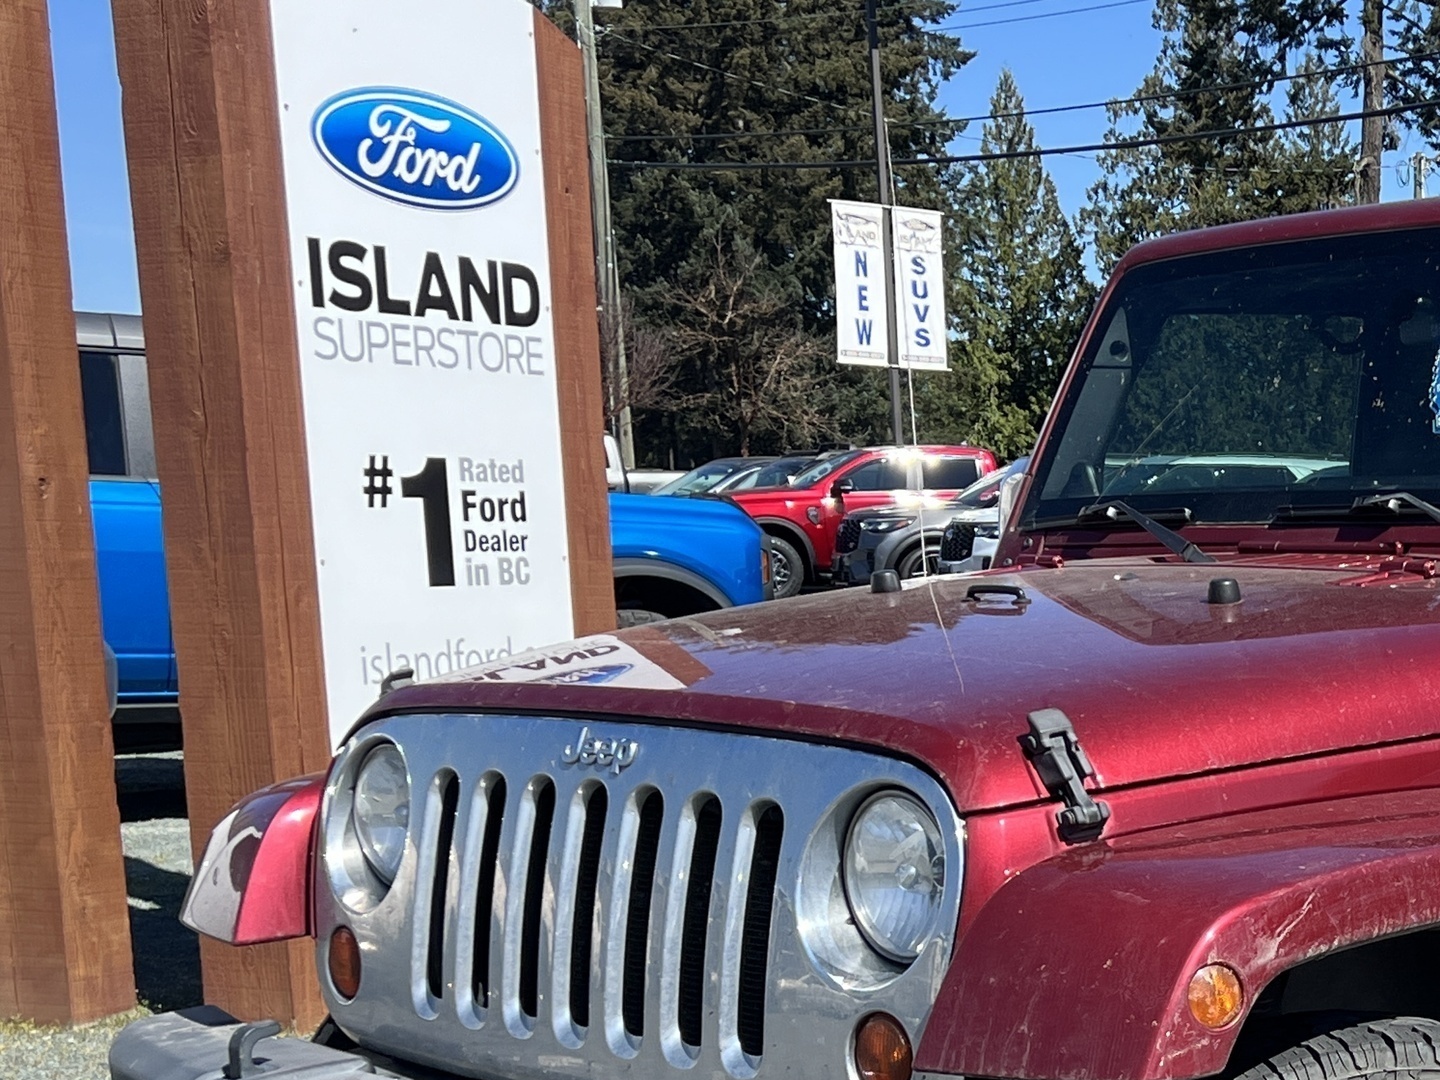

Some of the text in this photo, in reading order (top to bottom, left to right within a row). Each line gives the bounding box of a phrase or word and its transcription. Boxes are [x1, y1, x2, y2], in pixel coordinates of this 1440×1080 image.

[357, 103, 482, 194] Ford
[306, 236, 540, 328] ISLAND
[854, 250, 873, 346] NEW
[910, 255, 932, 348] SUVS
[312, 316, 545, 376] SUPERSTORE
[458, 456, 525, 483] Rated
[461, 489, 527, 522] Ford
[463, 528, 528, 552] Dealer
[465, 556, 531, 586] in BC
[561, 726, 639, 775] Jeep
